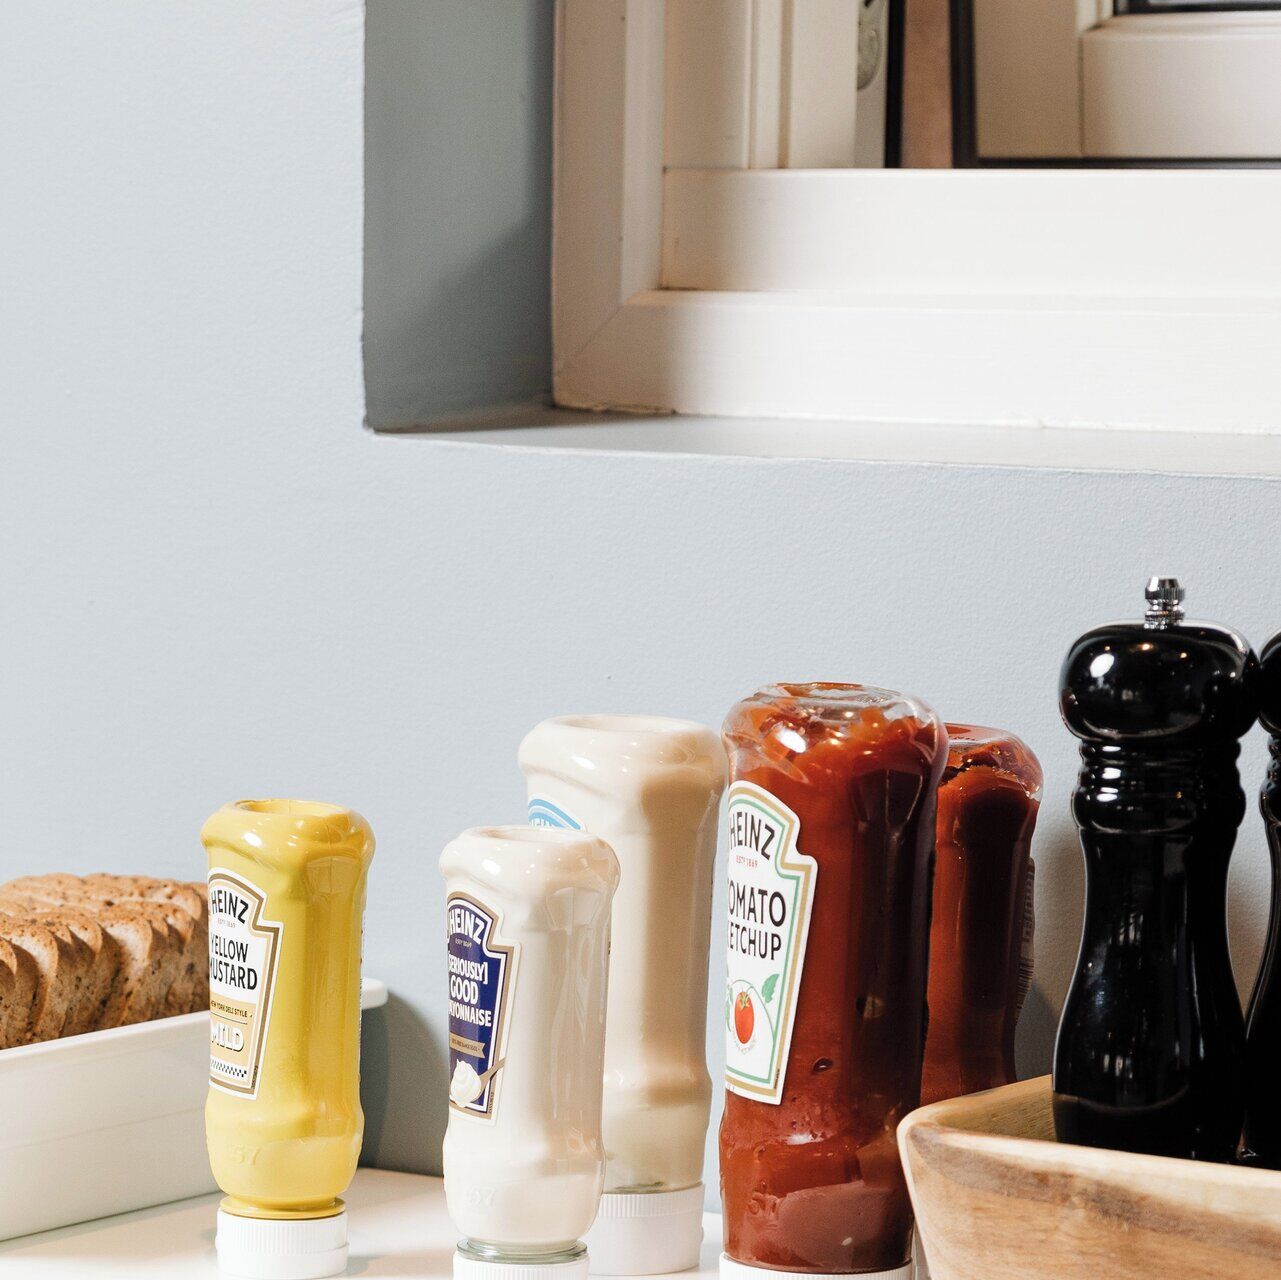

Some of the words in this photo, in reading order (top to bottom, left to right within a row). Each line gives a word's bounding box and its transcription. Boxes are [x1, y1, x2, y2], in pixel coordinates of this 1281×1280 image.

[730, 811, 775, 861] HEINZ
[211, 890, 249, 924] HEINZ
[727, 878, 787, 928] OMATO
[449, 908, 485, 945] HEINZ
[727, 920, 782, 961] ETCHUP
[450, 975, 479, 1005] GOOD
[234, 1008, 248, 1018] STYLE
[448, 1000, 492, 1027] AYONNAISE
[211, 1021, 245, 1052] MILD
